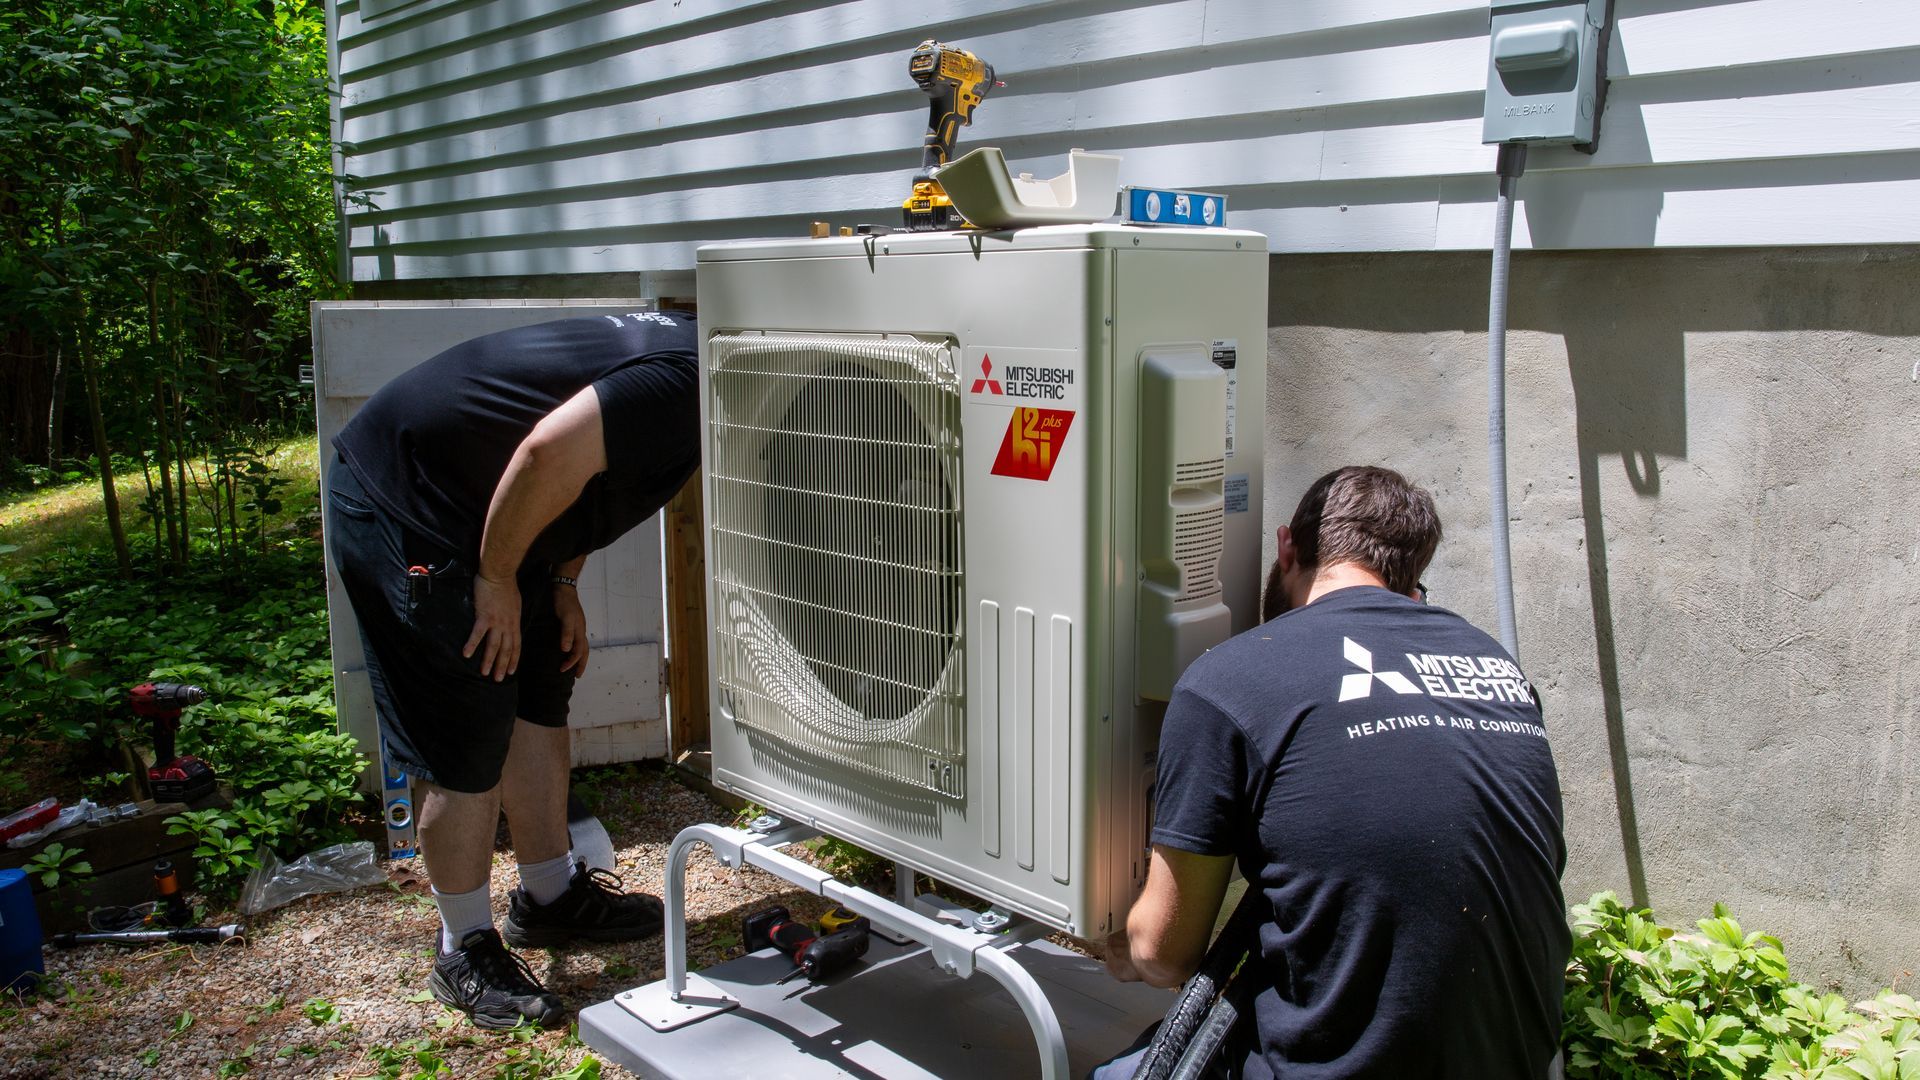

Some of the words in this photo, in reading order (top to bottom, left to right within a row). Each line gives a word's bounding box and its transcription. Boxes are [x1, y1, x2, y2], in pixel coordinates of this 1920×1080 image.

[1504, 103, 1556, 118] MILBANK
[1006, 366, 1074, 384] MITSUBISHI
[1006, 381, 1065, 400] ELECTRIC
[1041, 413, 1063, 429] plus
[1419, 677, 1535, 705] ELECTRIC
[1347, 714, 1430, 739] HEATING
[1435, 714, 1446, 727] &
[1450, 716, 1476, 730] AIR
